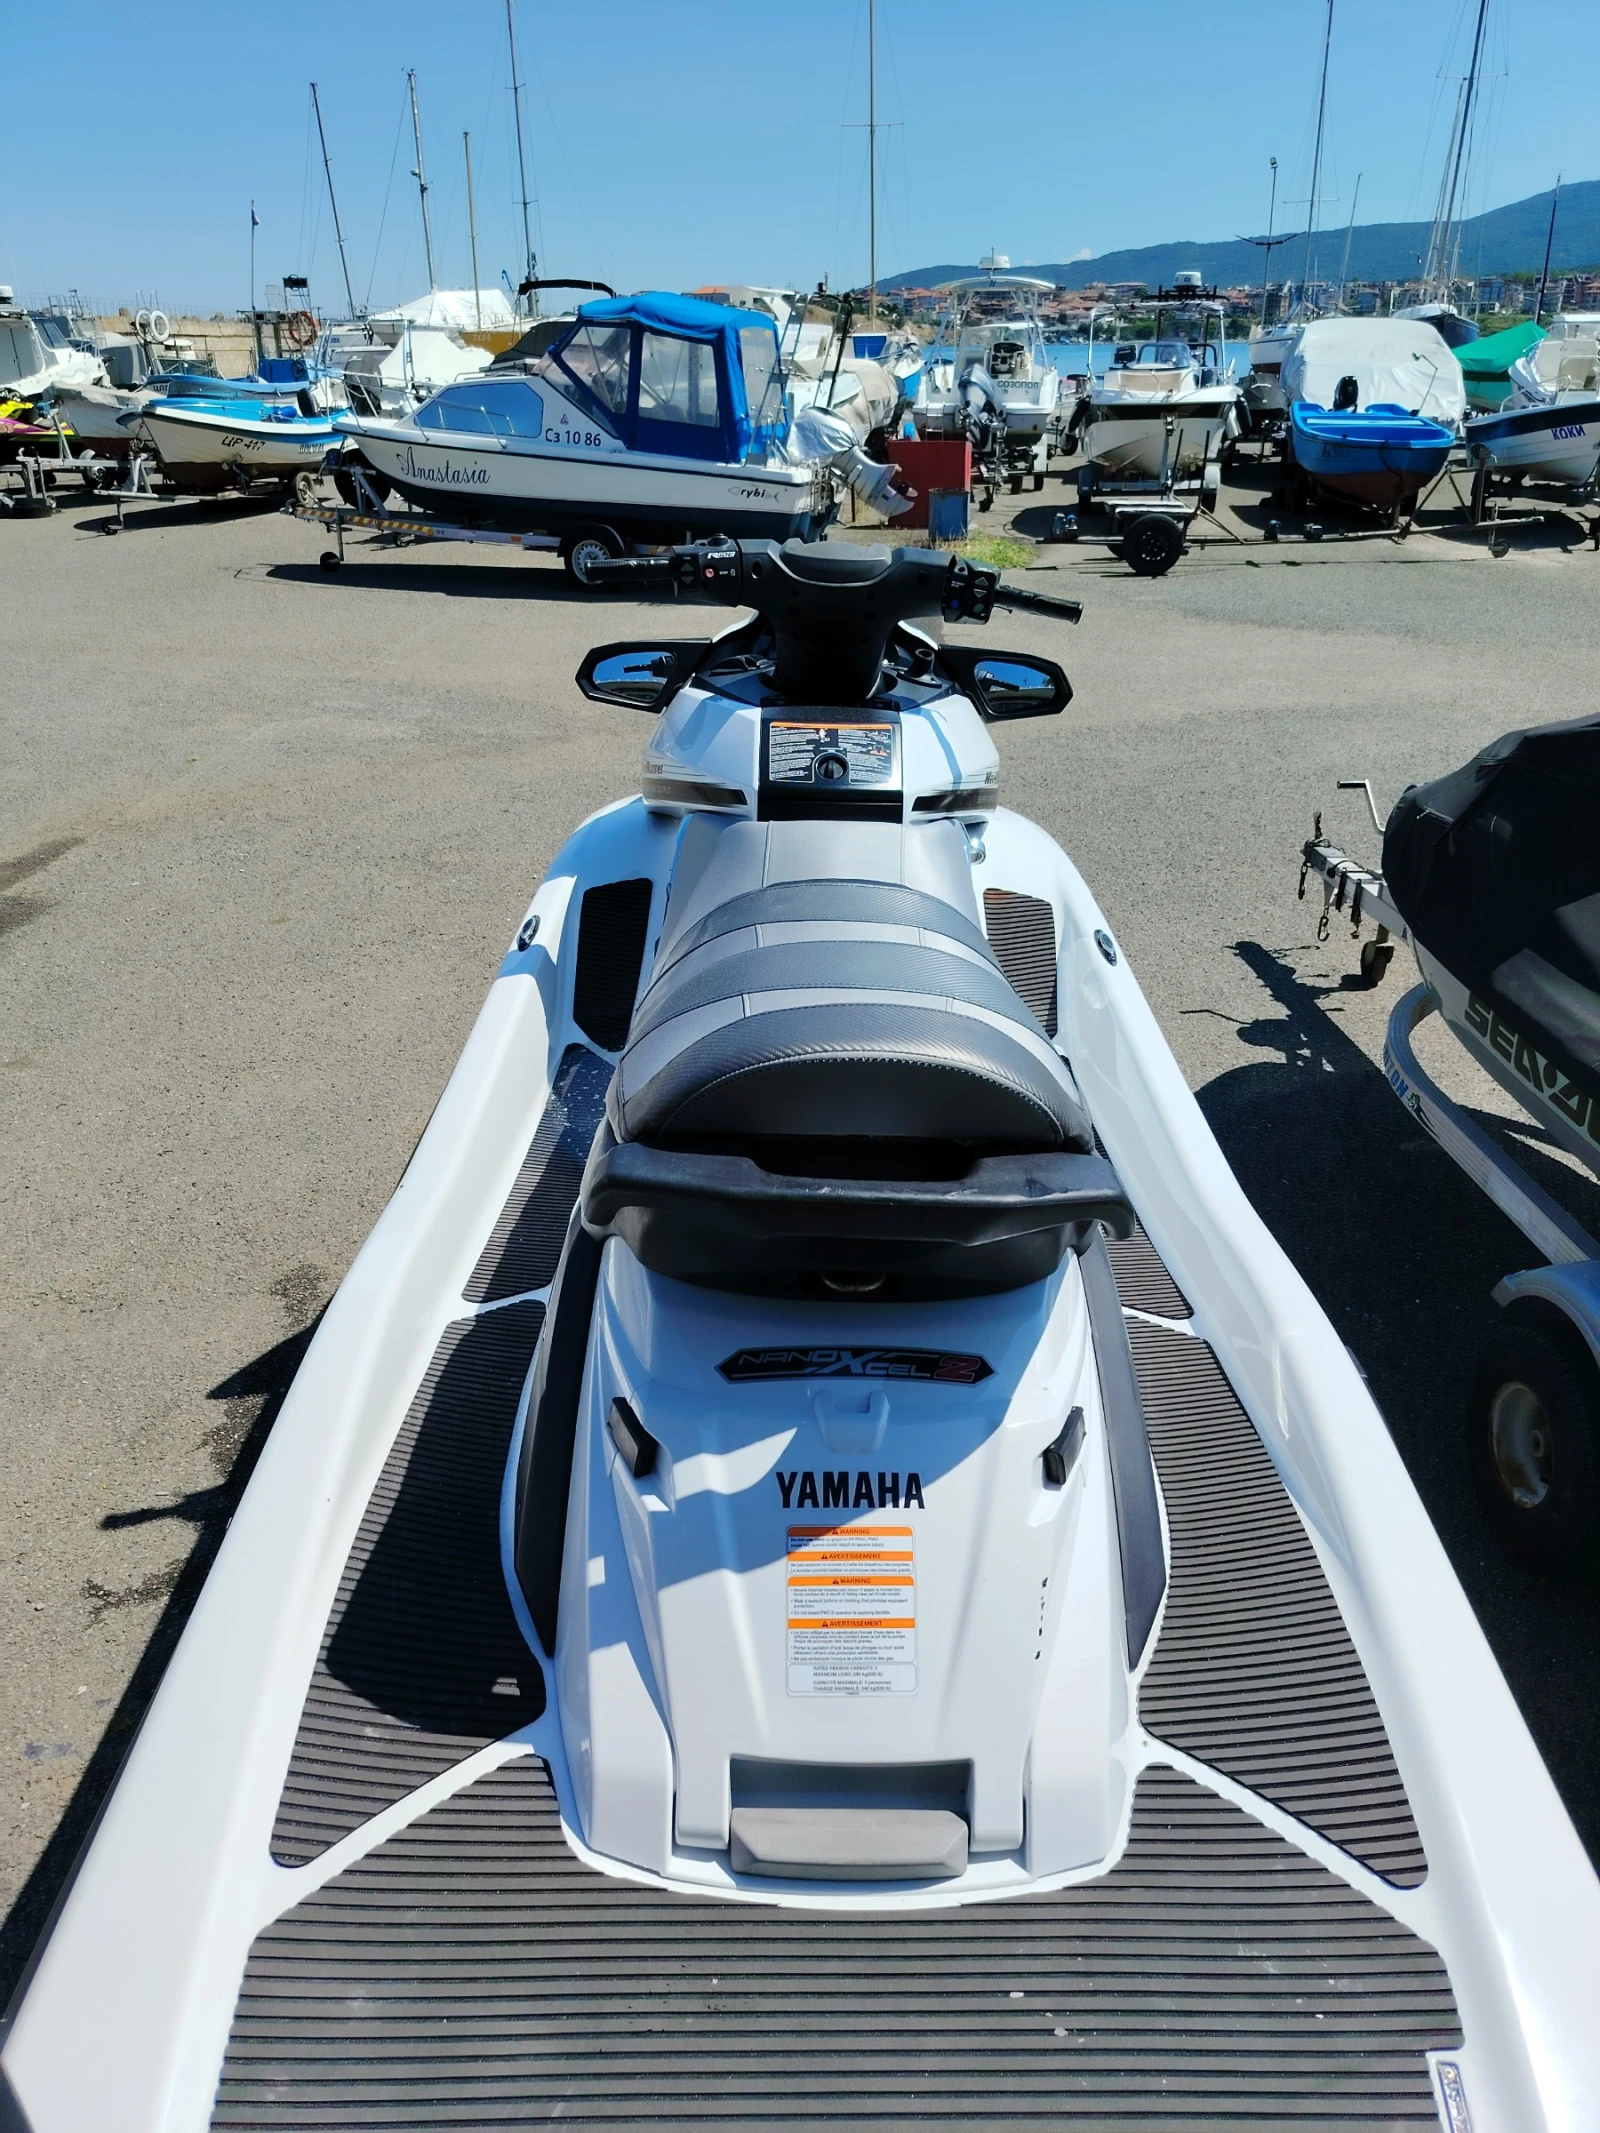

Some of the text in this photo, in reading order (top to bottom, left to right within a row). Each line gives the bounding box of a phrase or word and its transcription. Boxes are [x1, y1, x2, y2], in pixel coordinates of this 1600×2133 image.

[565, 430, 581, 445] 10
[584, 432, 602, 447] 86
[396, 446, 491, 484] Anastasia
[776, 1472, 926, 1510] YAMAHA
